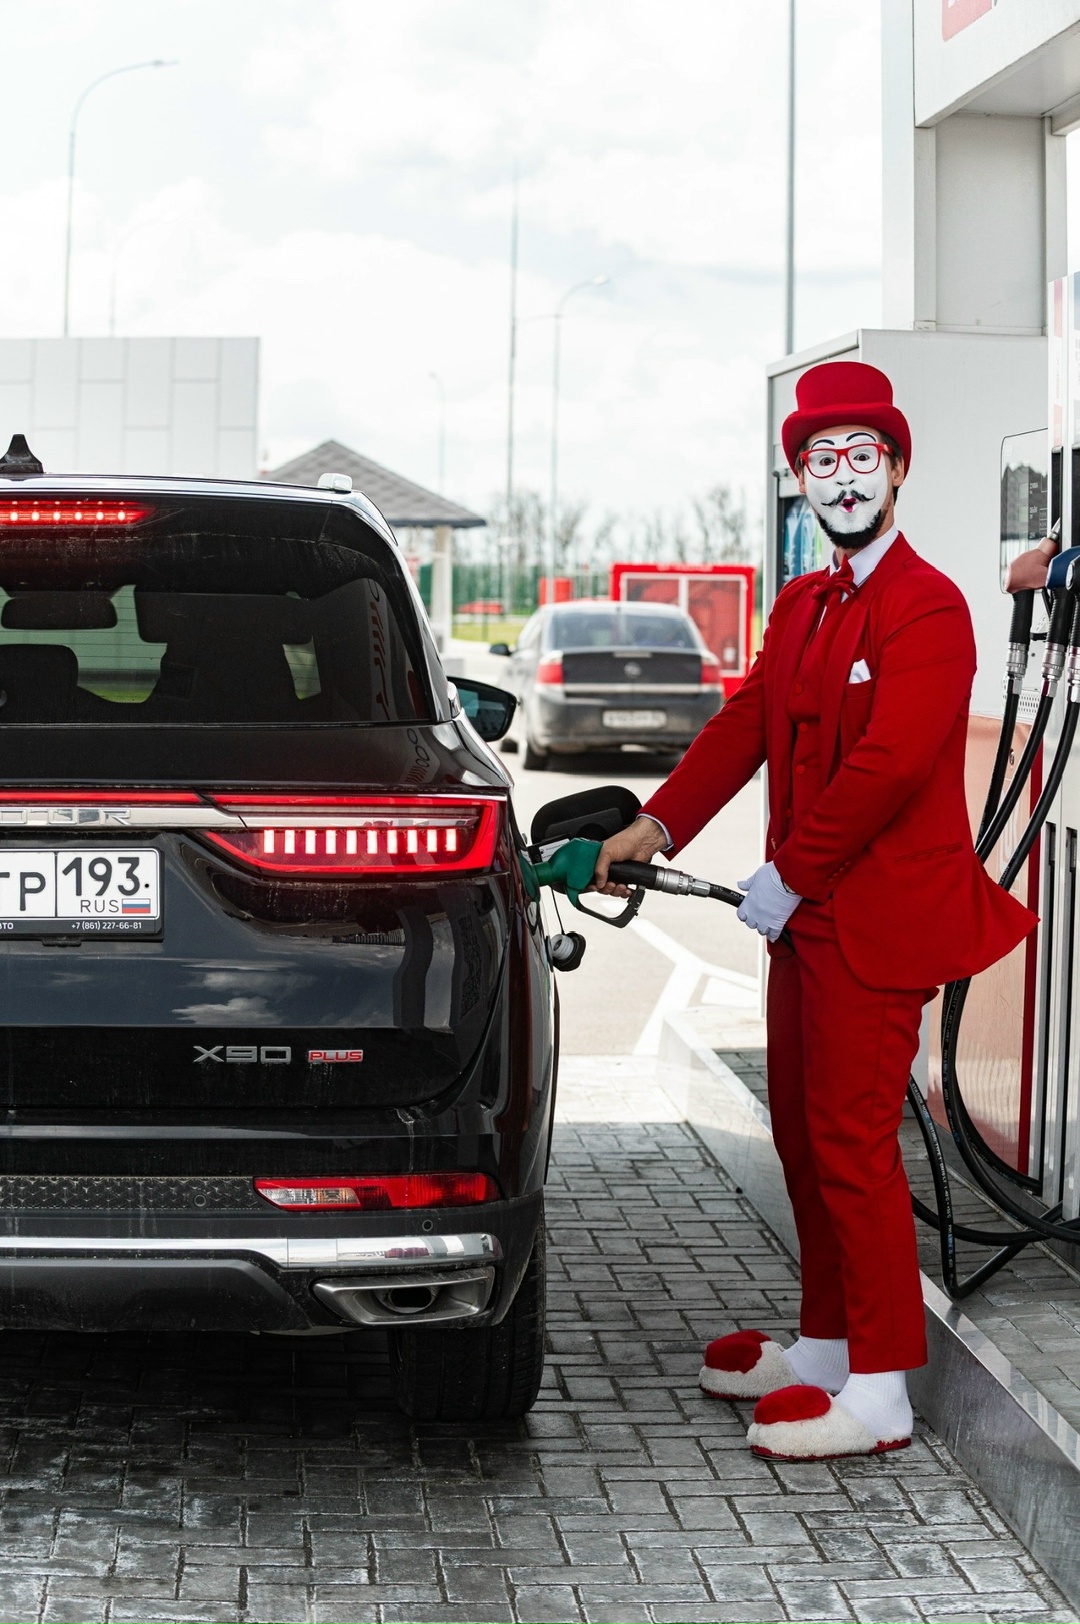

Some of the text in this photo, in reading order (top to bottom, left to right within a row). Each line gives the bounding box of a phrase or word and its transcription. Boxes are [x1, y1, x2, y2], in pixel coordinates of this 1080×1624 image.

[80, 900, 119, 913] RUS
[71, 921, 142, 931] +7 (861) 227-66-81
[193, 1045, 363, 1064] X90 PLUS
